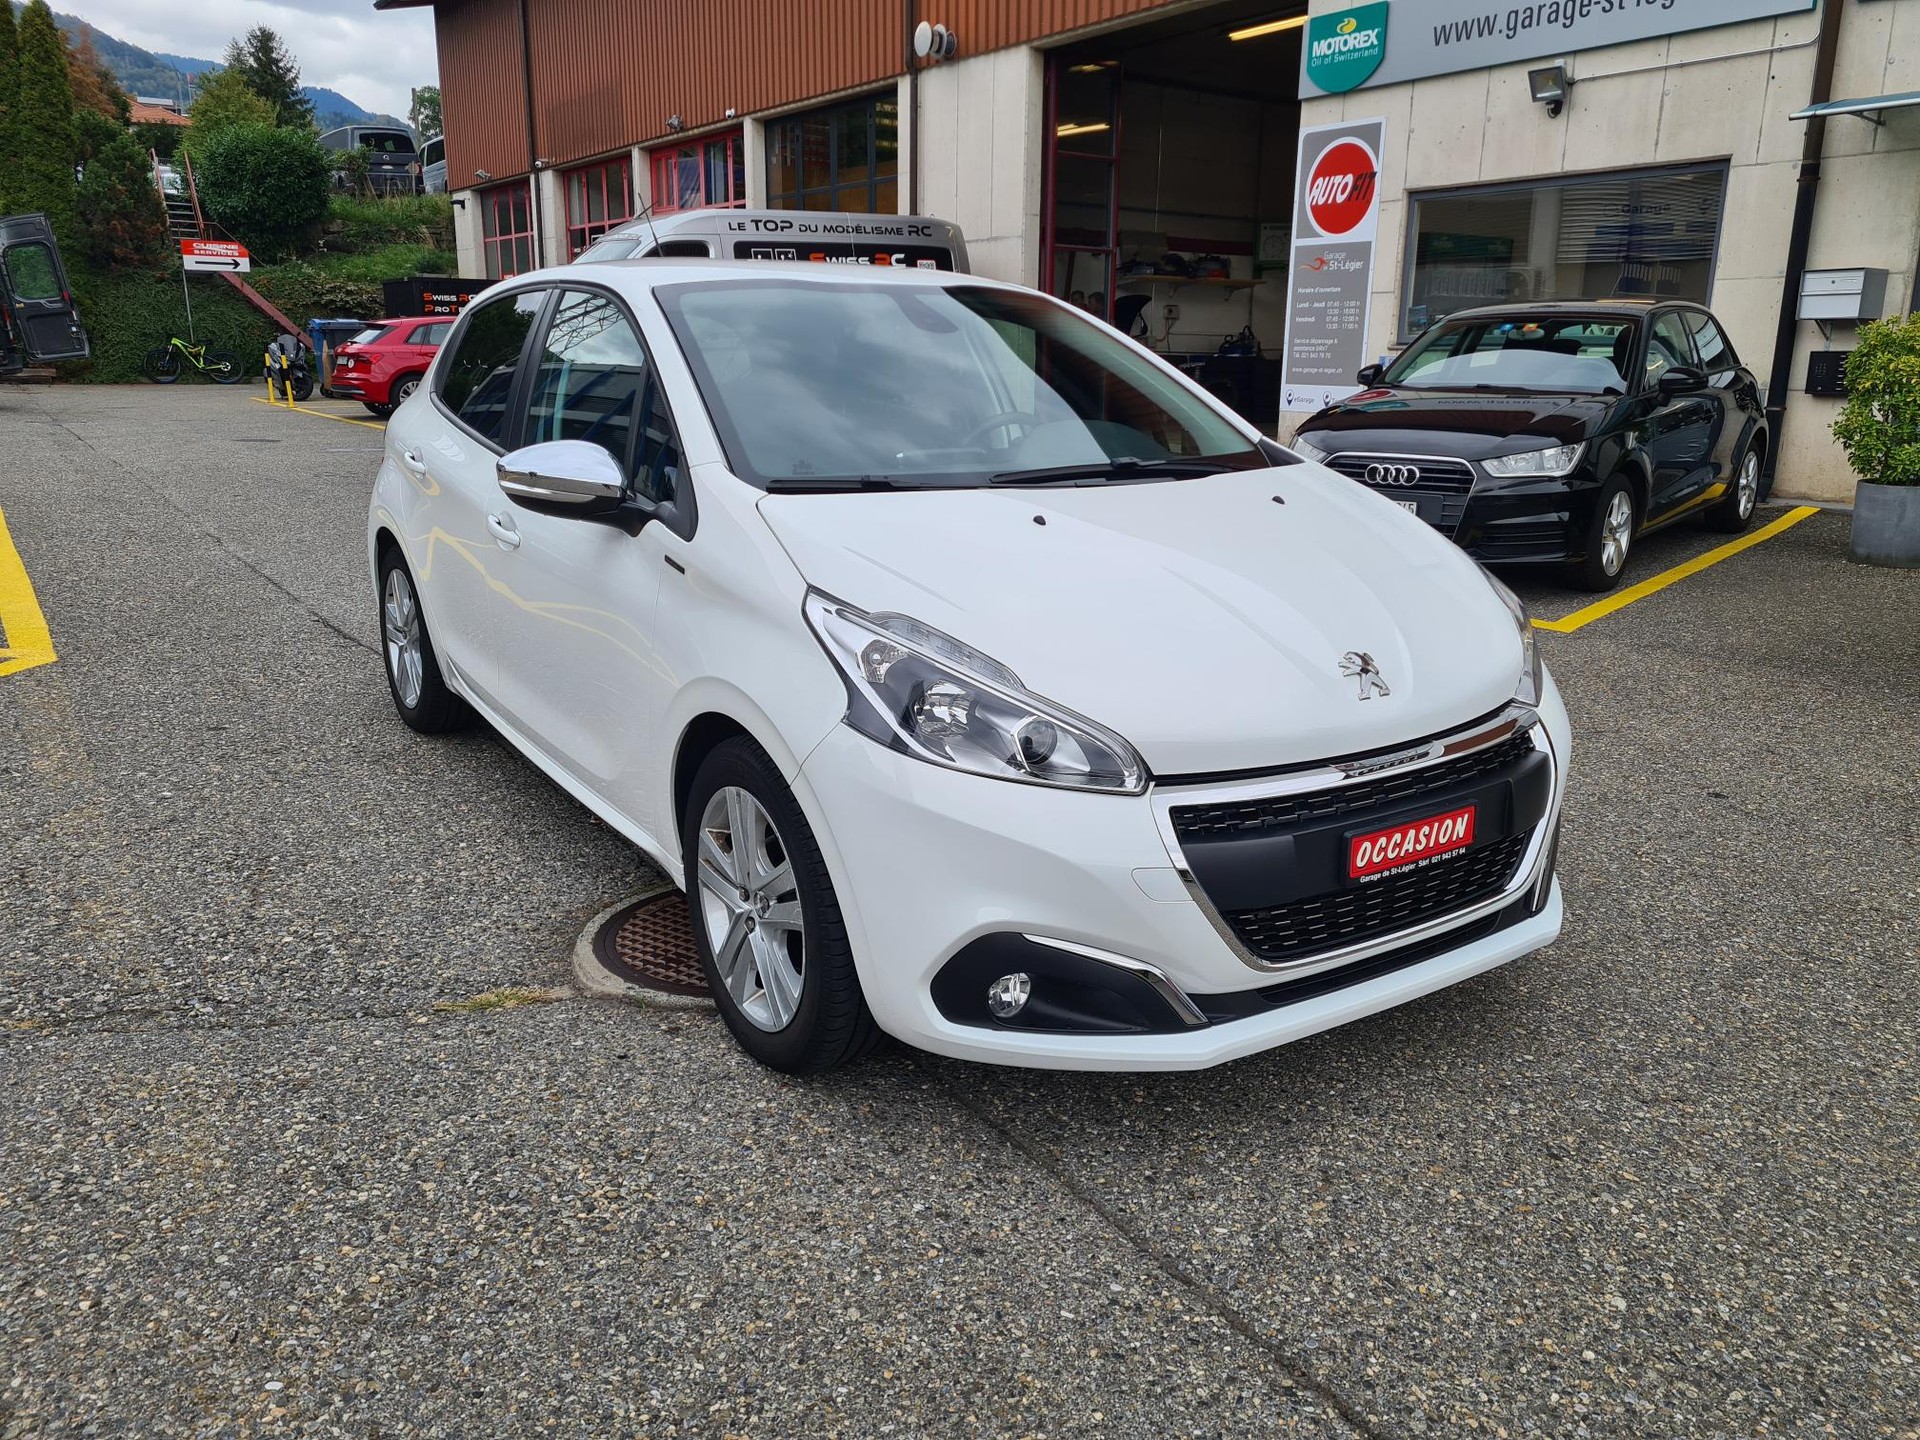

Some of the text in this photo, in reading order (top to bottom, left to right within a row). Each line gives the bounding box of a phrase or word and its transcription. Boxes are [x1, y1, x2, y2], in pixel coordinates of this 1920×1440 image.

[1311, 28, 1379, 57] MOTOREX
[1311, 47, 1379, 67] Oil of Switzerland
[729, 219, 933, 237] LE TOP DU MODÉLISME RC
[192, 242, 239, 250] CUISINE
[1324, 251, 1347, 261] Garage
[1329, 259, 1364, 272] St-Légier
[1355, 813, 1470, 868] OCCASION
[1360, 871, 1381, 883] Garage
[1382, 869, 1390, 878] de
[1390, 862, 1416, 876] St-Légier
[1431, 855, 1441, 864] 021
[1442, 851, 1452, 861] 943
